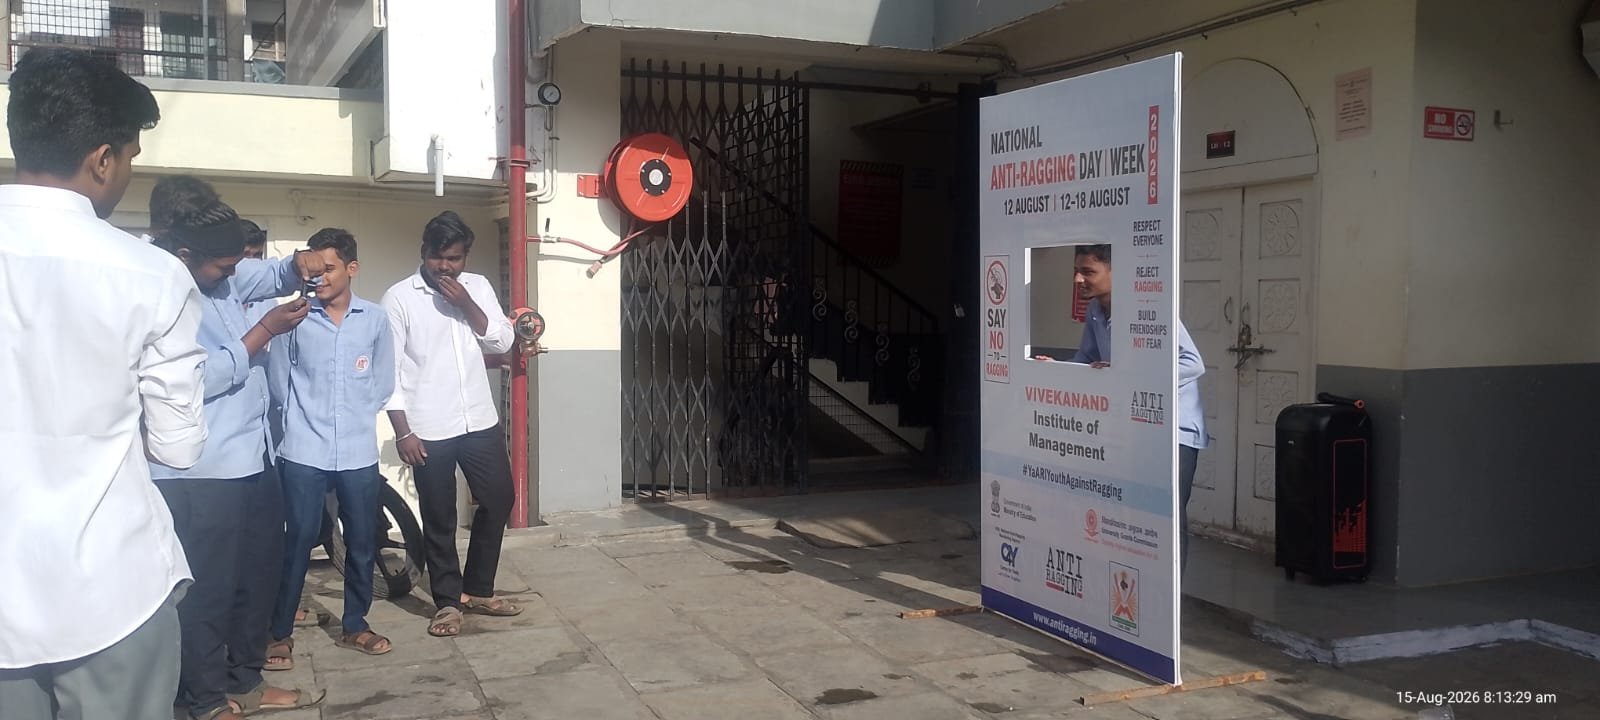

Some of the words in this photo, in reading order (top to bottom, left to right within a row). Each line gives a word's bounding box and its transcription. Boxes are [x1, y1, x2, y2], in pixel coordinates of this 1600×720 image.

[991, 125, 1042, 155] NATIONAL
[1149, 114, 1158, 198] 2026
[990, 153, 1076, 190] ANTI-RAGGING
[1079, 150, 1103, 180] DAY
[1110, 143, 1145, 176] WEEK
[1004, 199, 1013, 216] 12
[1015, 195, 1050, 214] AUGUST
[1089, 186, 1130, 208] AUGUST
[1133, 219, 1161, 232] RESPECT
[1133, 234, 1163, 247] EVERYONE
[1136, 266, 1159, 278] REJECT
[1134, 281, 1163, 293] RAGGING
[987, 308, 1007, 328] SAY
[1138, 310, 1157, 321] BUILD
[1129, 323, 1167, 336] FRIENDSHIPS
[989, 330, 1004, 350] NO
[1133, 337, 1146, 349] NOT
[1146, 338, 1162, 350] FEAR
[986, 362, 1009, 377] RAGGING
[1025, 386, 1109, 412] VIVEKANAND
[1131, 390, 1164, 410] ANTI
[1034, 410, 1083, 433] Institute
[1086, 419, 1099, 436] of
[1131, 407, 1164, 424] RAGGING
[1029, 432, 1105, 461] Management
[1046, 546, 1083, 579] ANTI
[1046, 568, 1083, 597] RAGGING
[1033, 611, 1097, 646] www.antiragging.in
